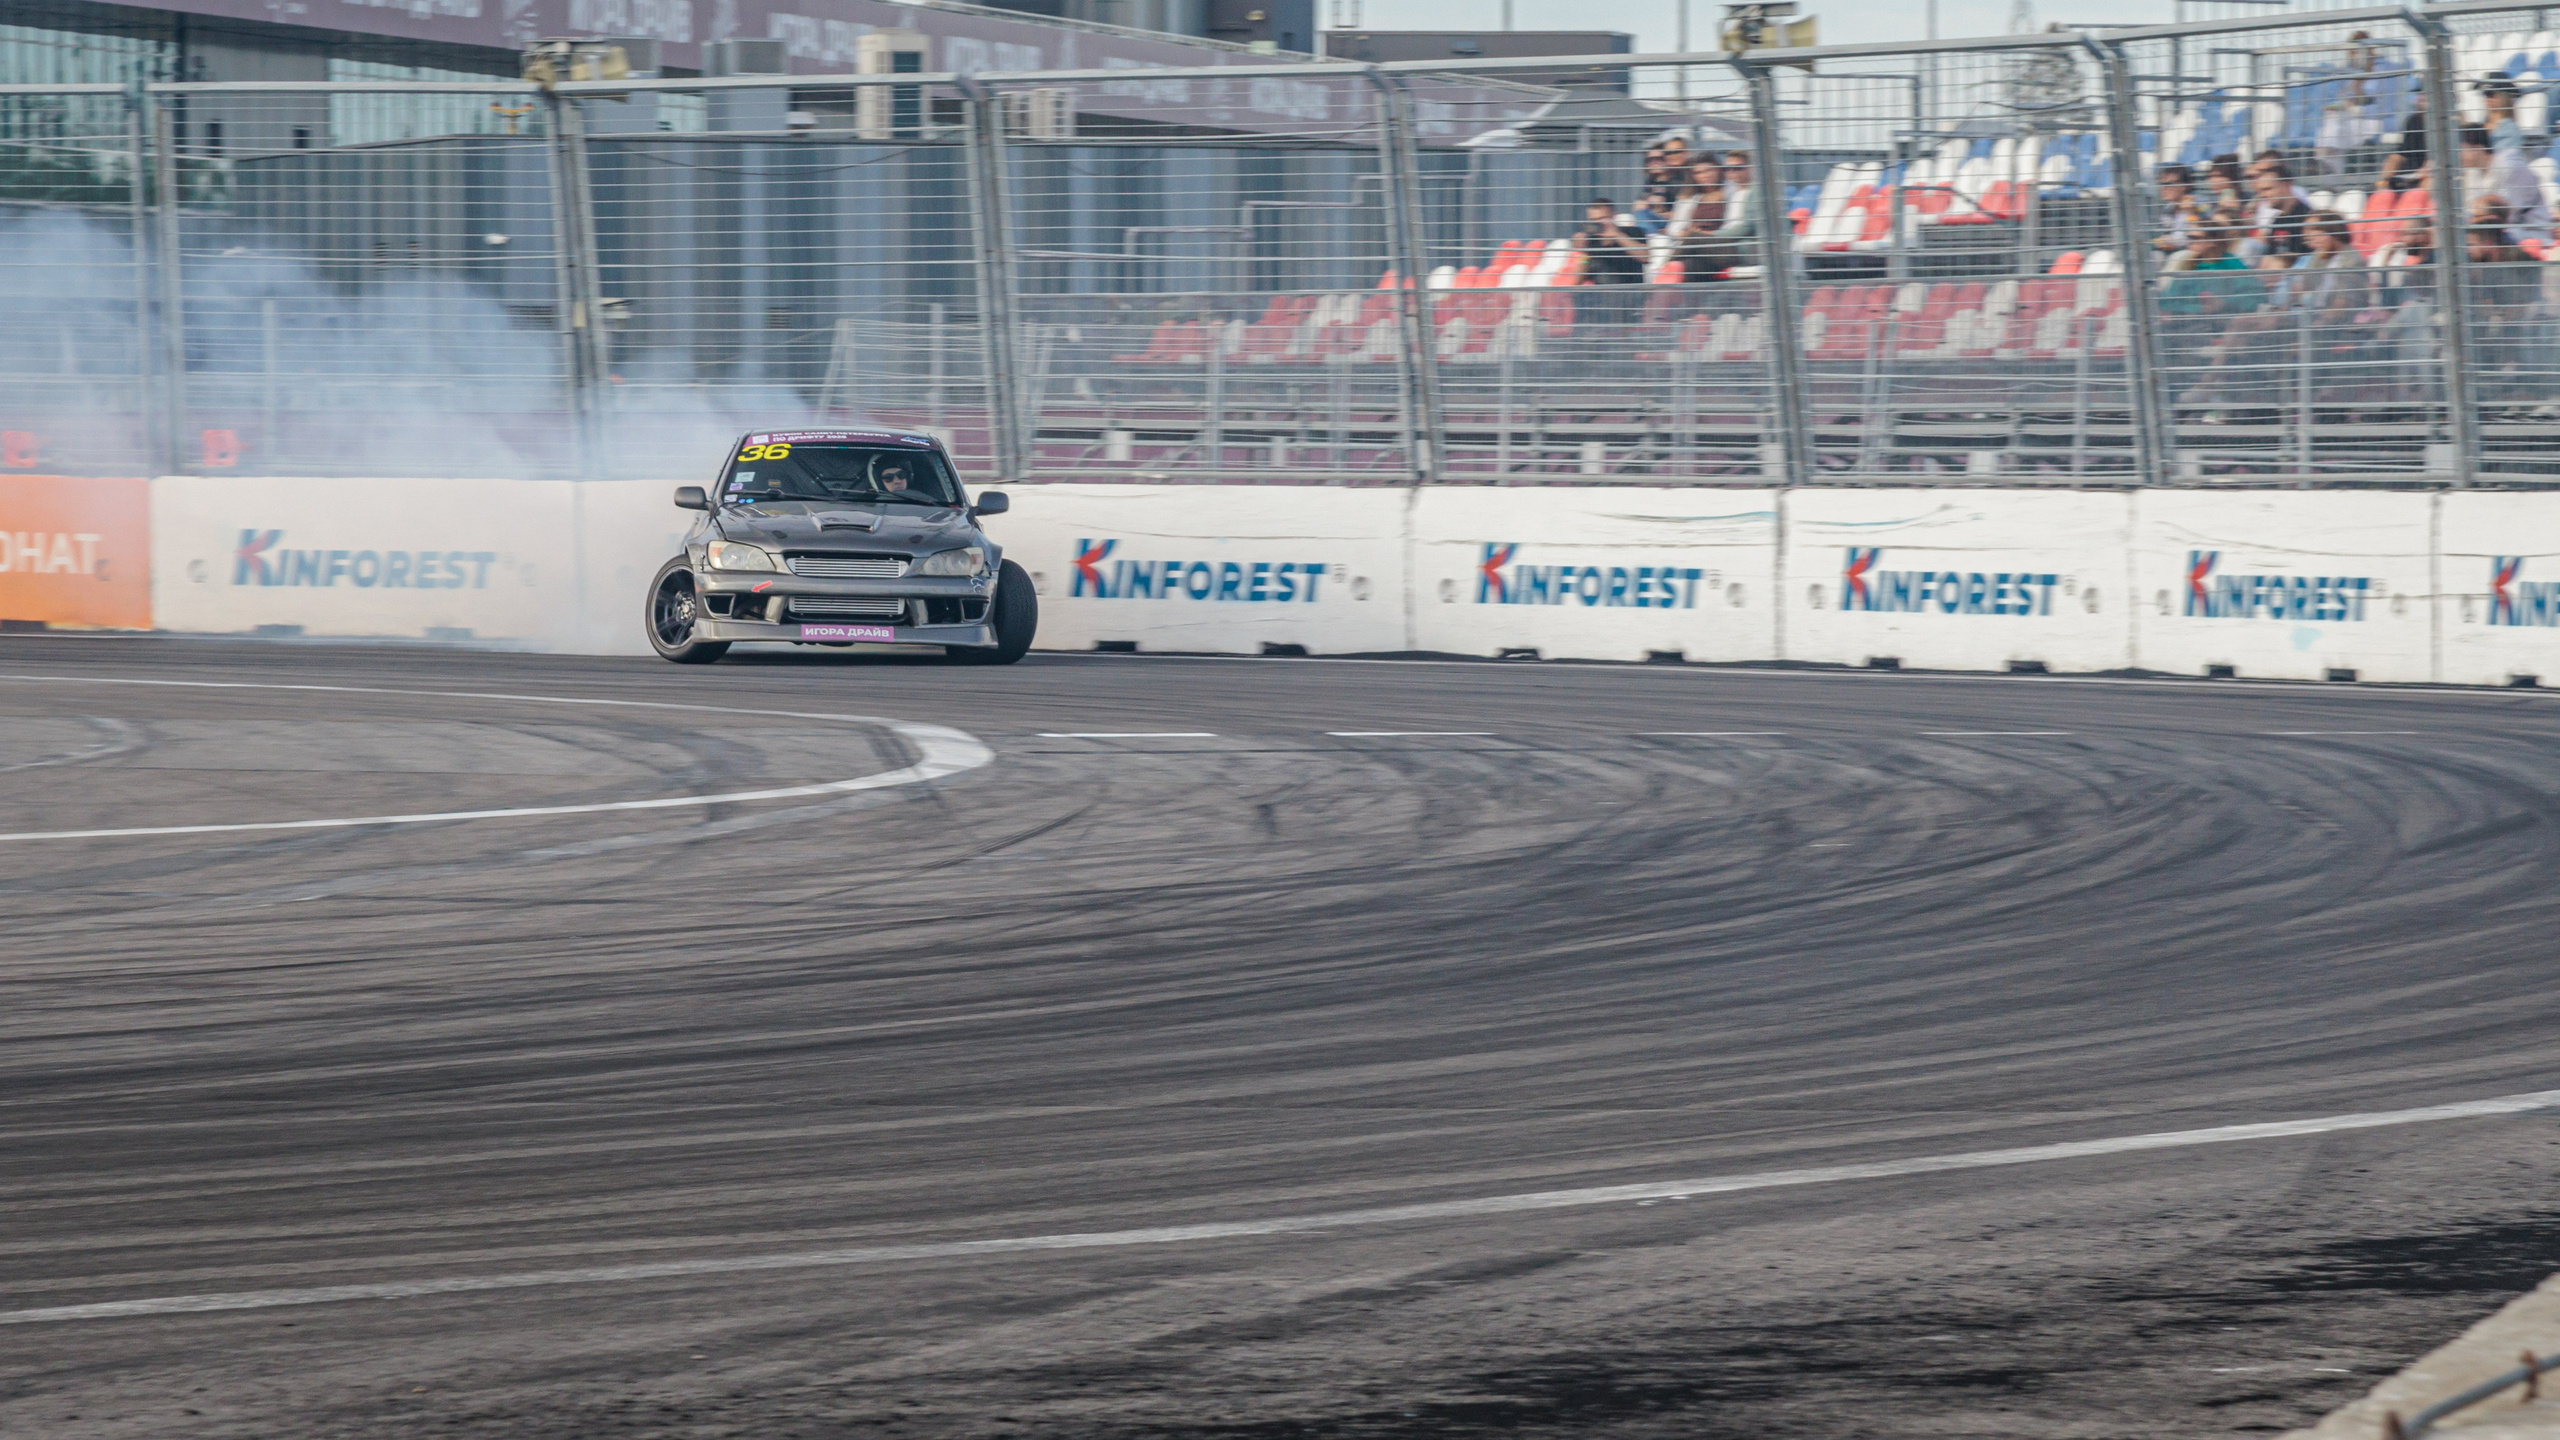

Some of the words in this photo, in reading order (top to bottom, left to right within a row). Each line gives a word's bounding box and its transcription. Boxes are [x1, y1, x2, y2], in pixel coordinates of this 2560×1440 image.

[737, 443, 792, 462] 36
[232, 528, 497, 590] KINFOREST
[1068, 538, 1327, 602] KINFOREST
[1473, 542, 1705, 609] KINFOREST
[1840, 547, 2059, 616] KINFOREST
[2183, 550, 2372, 621] KINFOREST
[805, 627, 845, 636] ИГОРА
[847, 627, 890, 638] ДРАЙВ
